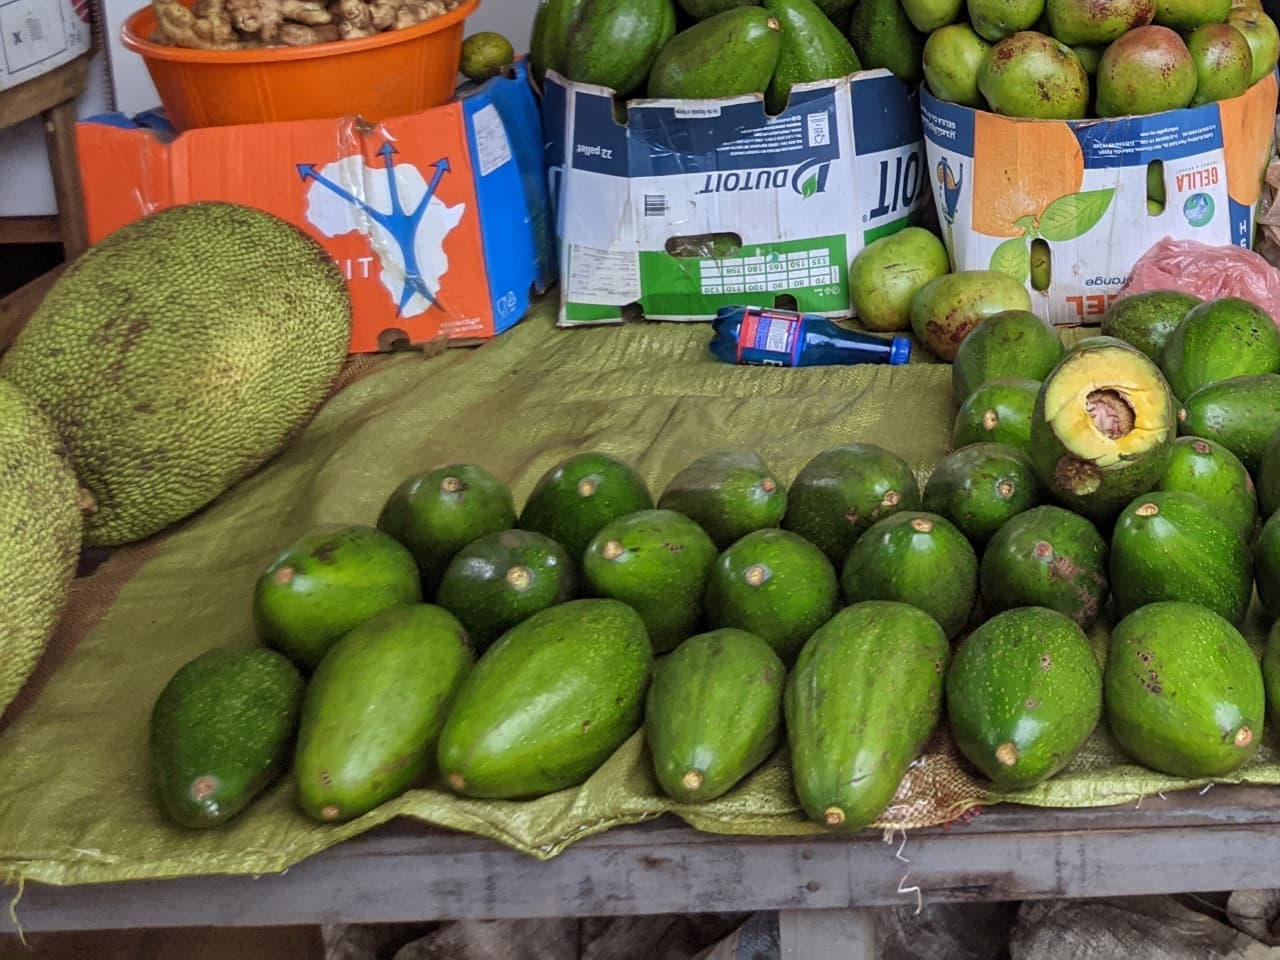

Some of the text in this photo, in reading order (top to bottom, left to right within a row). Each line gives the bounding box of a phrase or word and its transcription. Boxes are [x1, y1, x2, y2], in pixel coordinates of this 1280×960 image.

[576, 144, 613, 159] 22 pallet
[701, 169, 788, 193] DUTOIT
[870, 151, 924, 220] OIT
[1175, 166, 1219, 193] GELILA
[335, 256, 374, 280] IT
[725, 267, 741, 275] 198
[747, 265, 763, 274] 180
[790, 260, 806, 269] 150
[703, 277, 826, 294] 70 80 90 100 110 120
[1086, 276, 1131, 288] range
